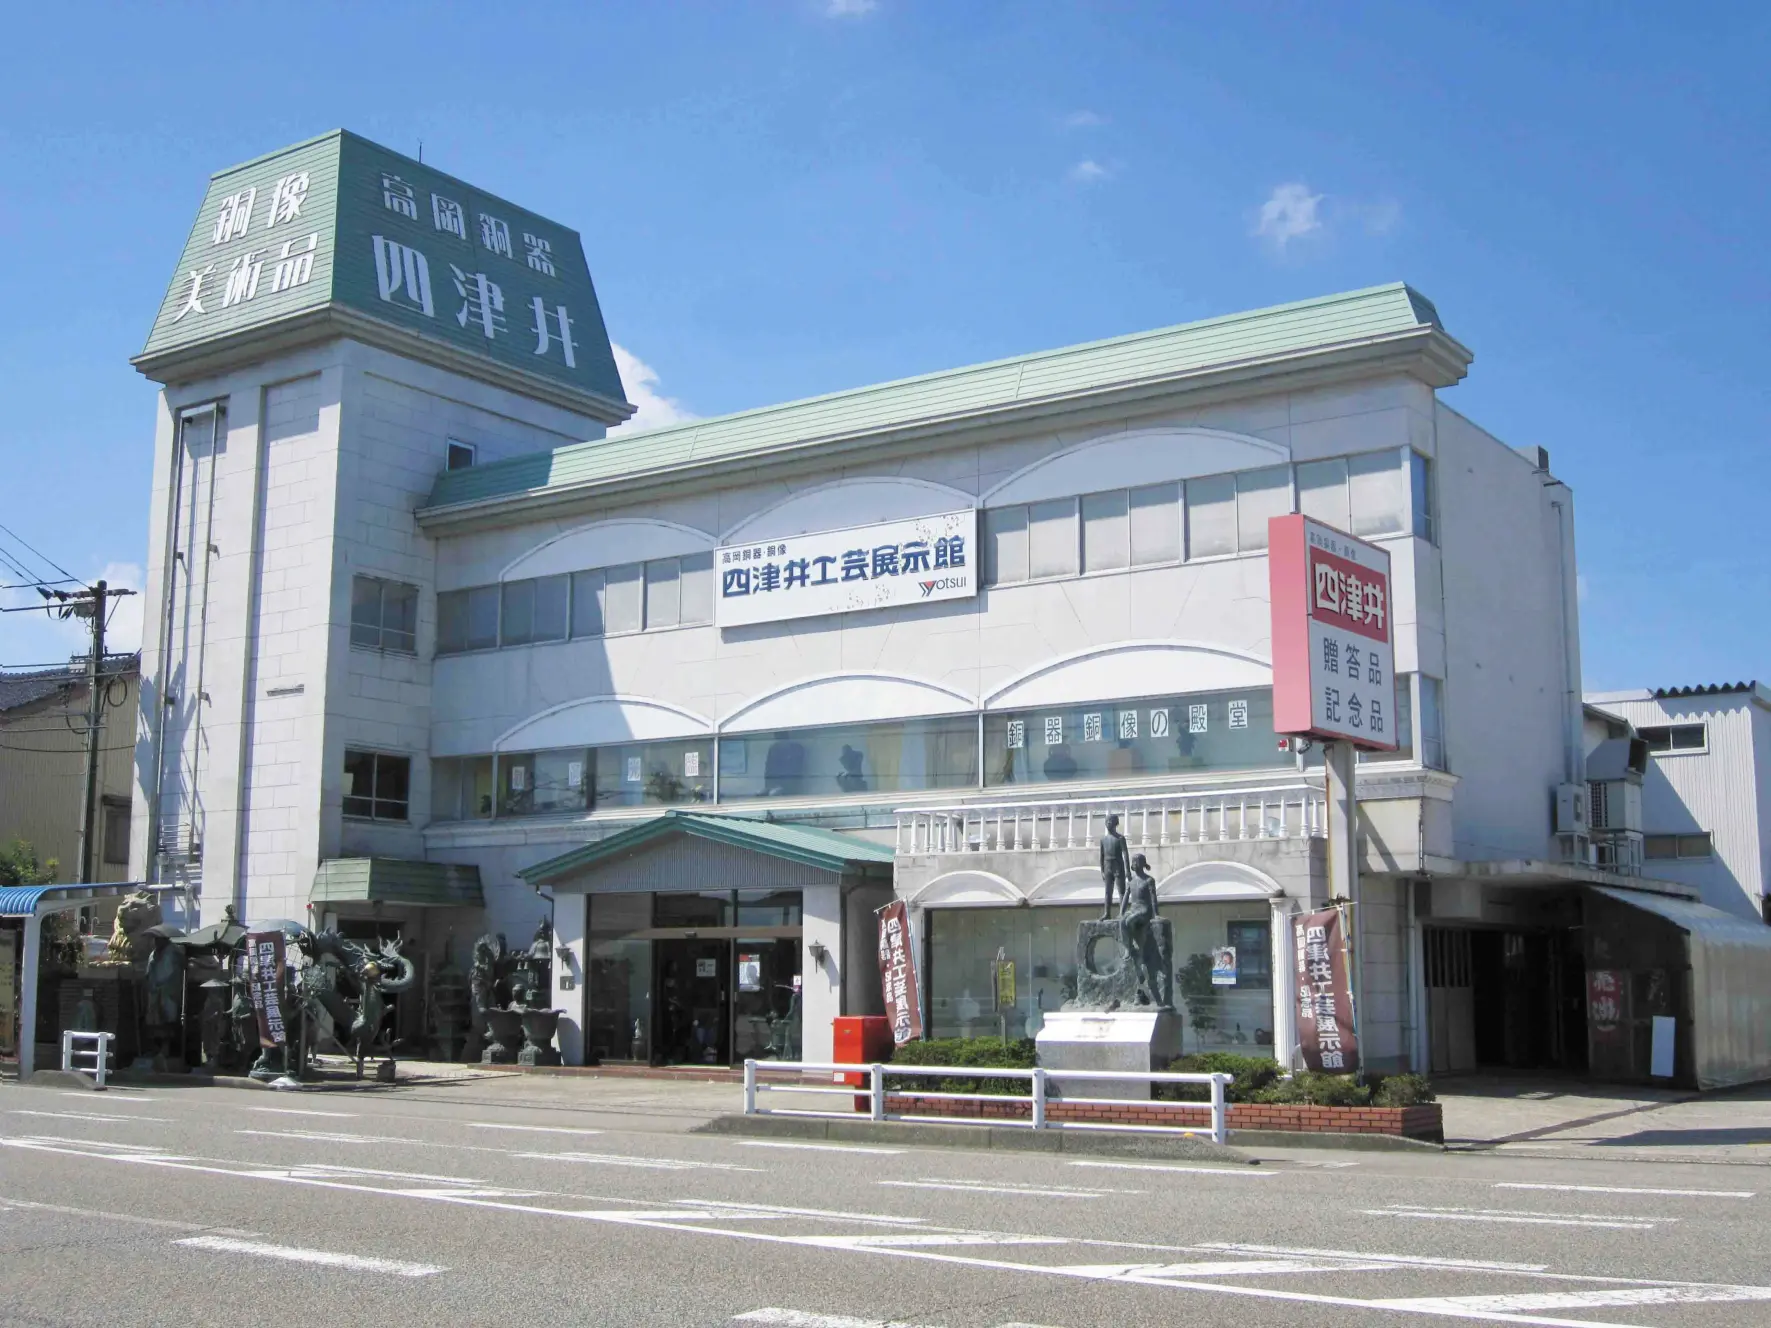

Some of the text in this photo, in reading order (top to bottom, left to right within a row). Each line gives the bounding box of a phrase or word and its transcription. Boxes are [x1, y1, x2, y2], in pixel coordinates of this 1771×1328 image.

[212, 171, 310, 246] 銅像
[380, 171, 556, 278] 高岡銅器
[171, 231, 319, 324] 美術品
[371, 234, 580, 369] 四津井
[722, 534, 966, 598] 四津井工芸展示館
[1314, 562, 1385, 629] 四津井
[1323, 637, 1383, 687] 贈答品
[1007, 700, 1248, 748] 銅器銅像の殿堂
[1324, 686, 1384, 733] 記念品
